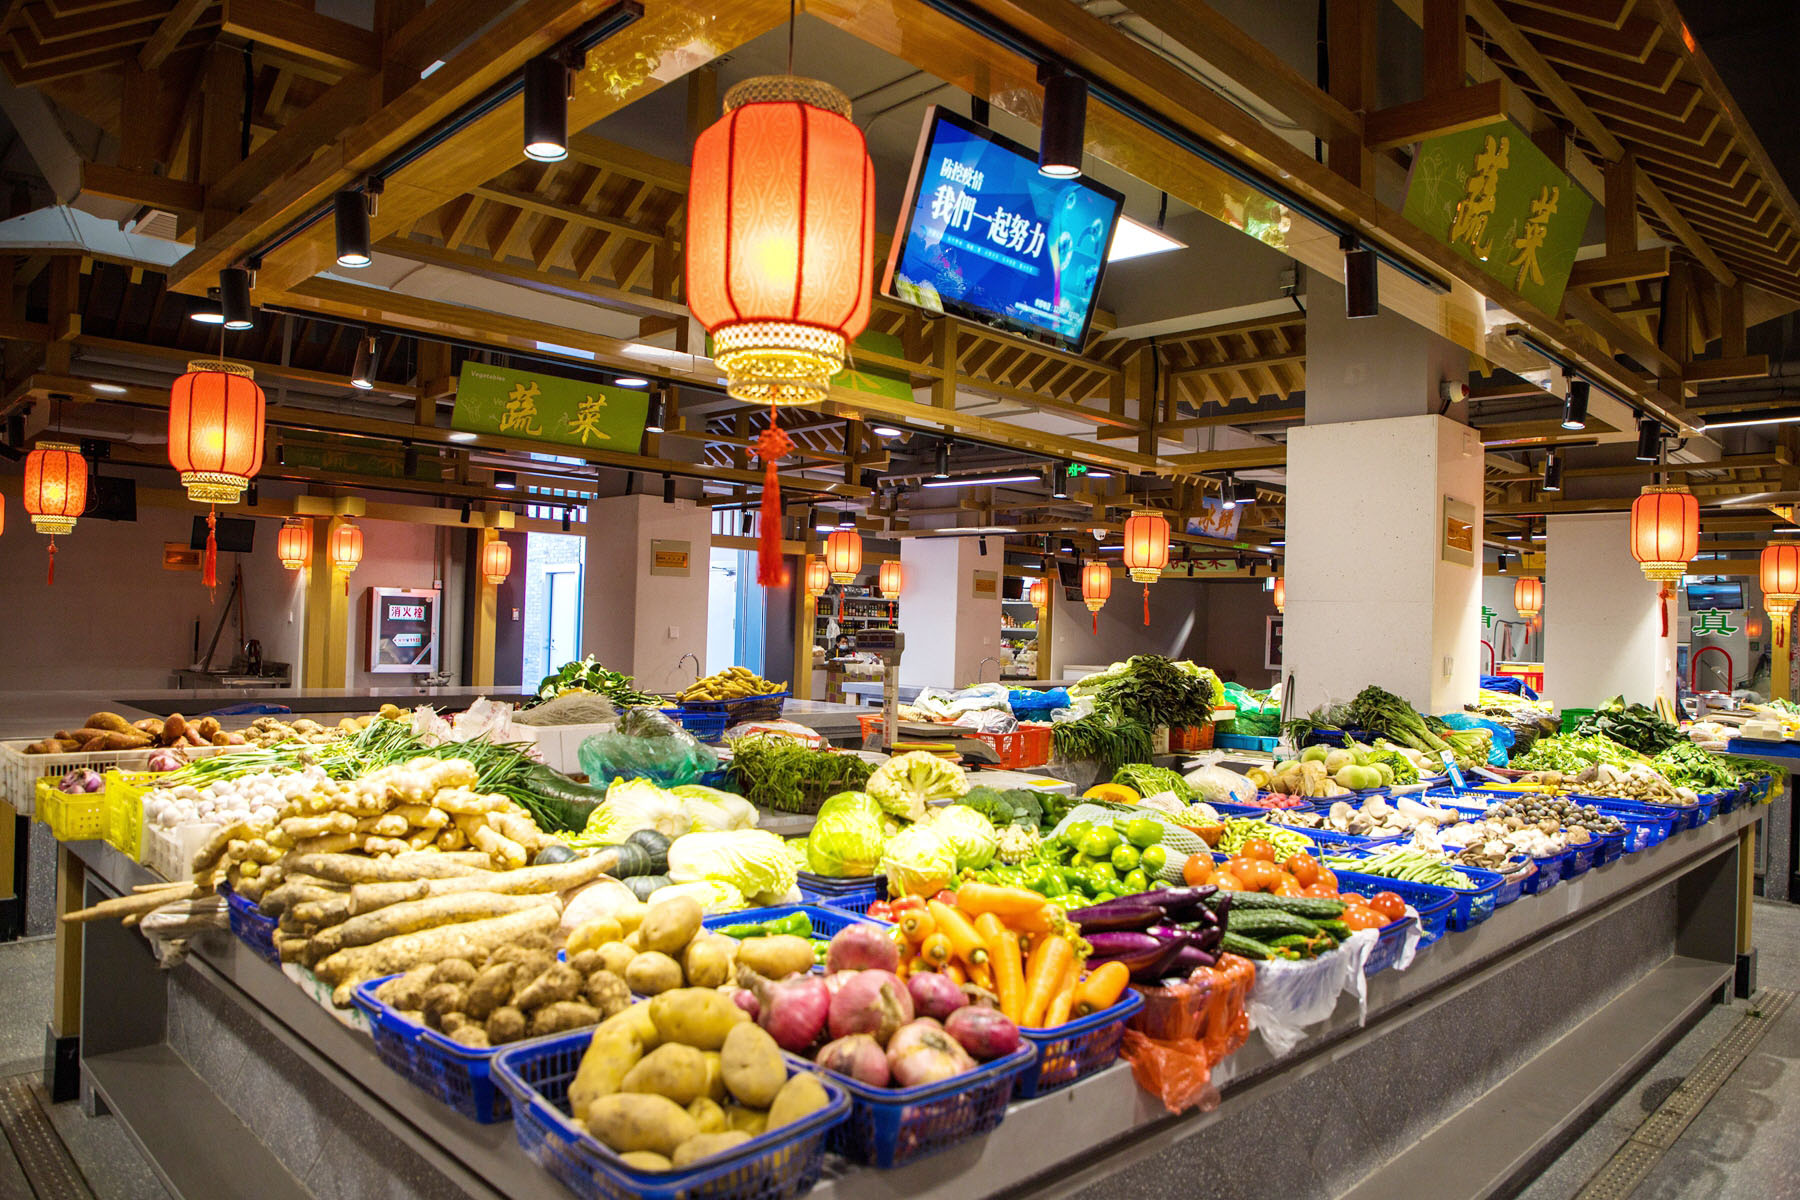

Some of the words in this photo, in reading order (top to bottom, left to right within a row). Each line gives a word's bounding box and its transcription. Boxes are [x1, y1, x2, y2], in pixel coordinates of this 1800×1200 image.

[939, 157, 984, 191] 防控疫情
[931, 184, 1046, 258] 我們一起努力
[1450, 134, 1560, 292] 蔬菜
[499, 381, 612, 445] 蔬菜
[391, 606, 423, 618] 消火栓
[1692, 607, 1739, 637] 真
